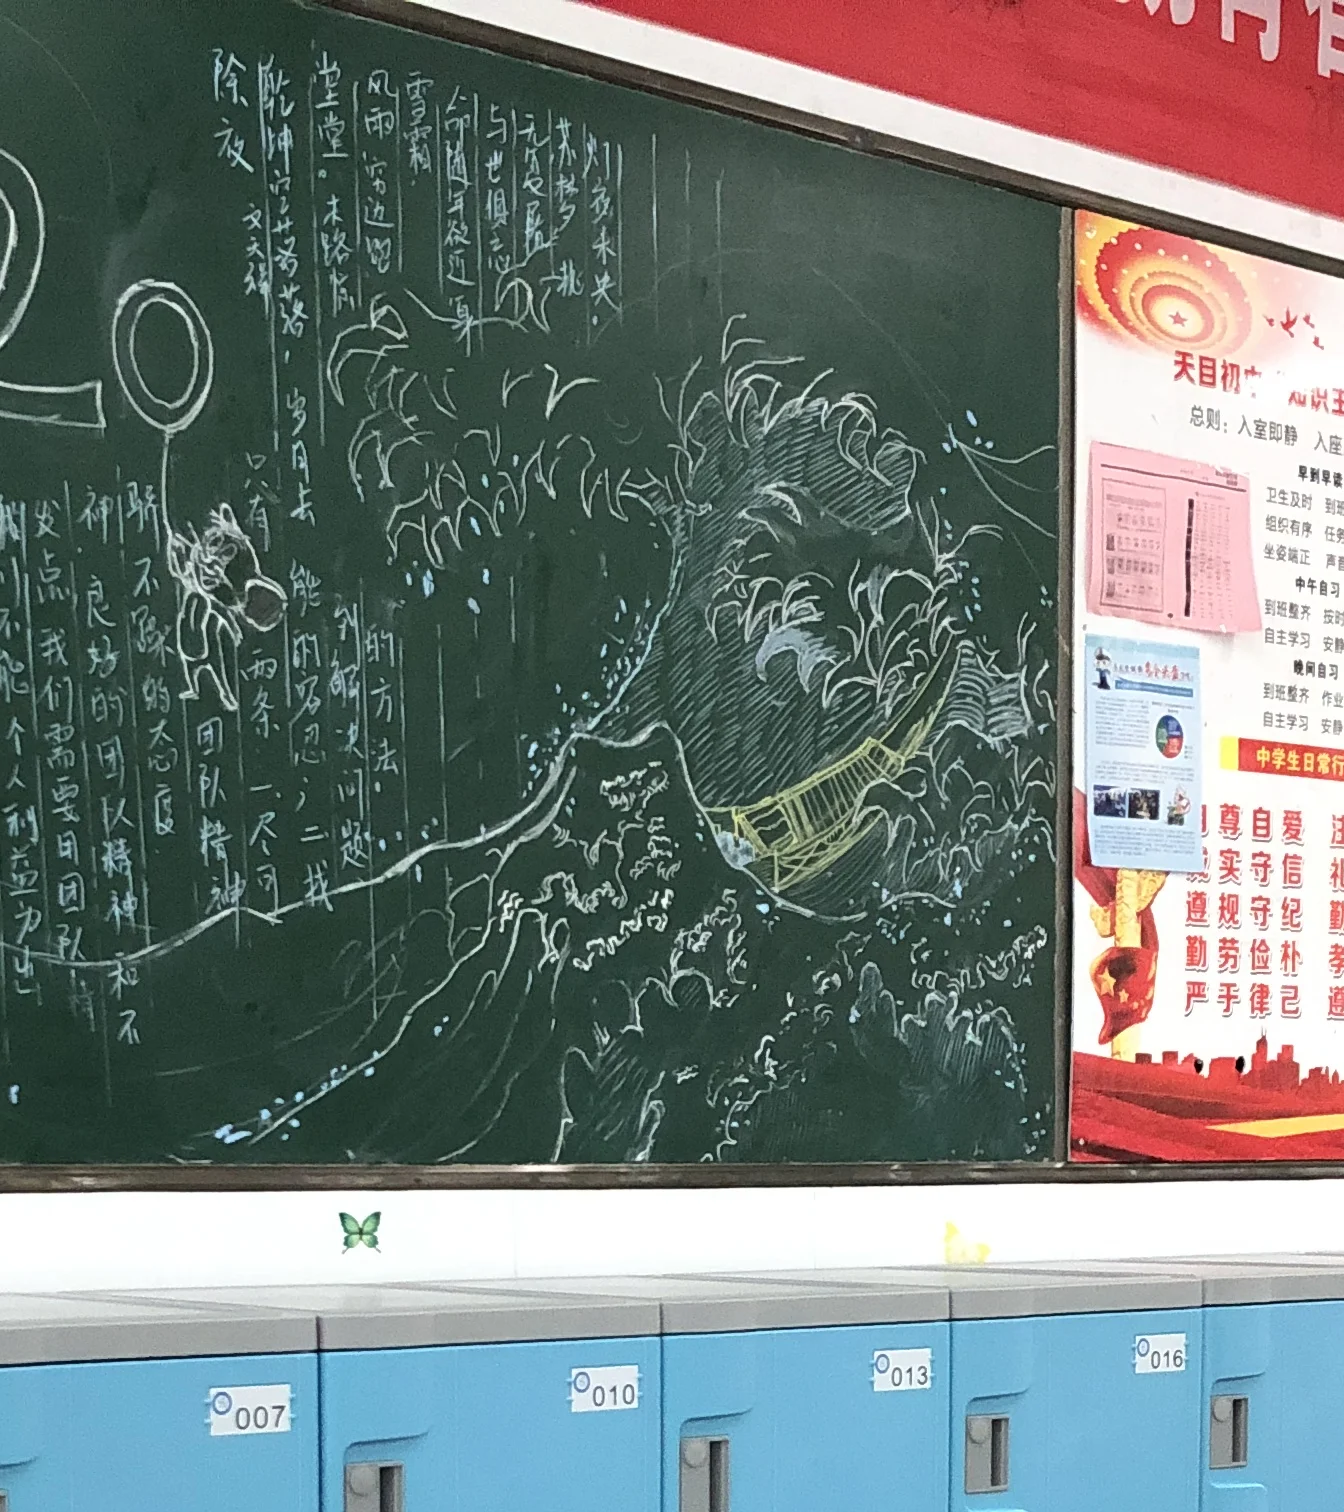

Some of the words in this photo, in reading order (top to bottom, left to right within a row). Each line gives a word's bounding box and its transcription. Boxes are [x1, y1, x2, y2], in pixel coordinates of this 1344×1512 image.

[1298, 464, 1344, 489] 早到早读
[1266, 487, 1312, 511] 卫生及时
[1265, 515, 1312, 539] 组织有序
[1264, 543, 1311, 567] 坐姿端正
[1295, 576, 1340, 599] 中午自习
[1264, 599, 1311, 622] 到班整齐
[1264, 627, 1311, 649] 自主学习
[1293, 659, 1339, 680] 晚间自习
[1263, 682, 1310, 704] 到班整齐
[1263, 711, 1309, 731] 自主学习
[197, 717, 247, 949] 团队精神
[1185, 890, 1304, 931] 遵规守纪
[1185, 935, 1303, 975] 勤劳俭朴
[1184, 980, 1302, 1018] 严于律己
[1150, 1349, 1184, 1370] 016
[890, 1363, 929, 1388] 013
[591, 1382, 637, 1408] 010
[233, 1404, 288, 1432] 007
